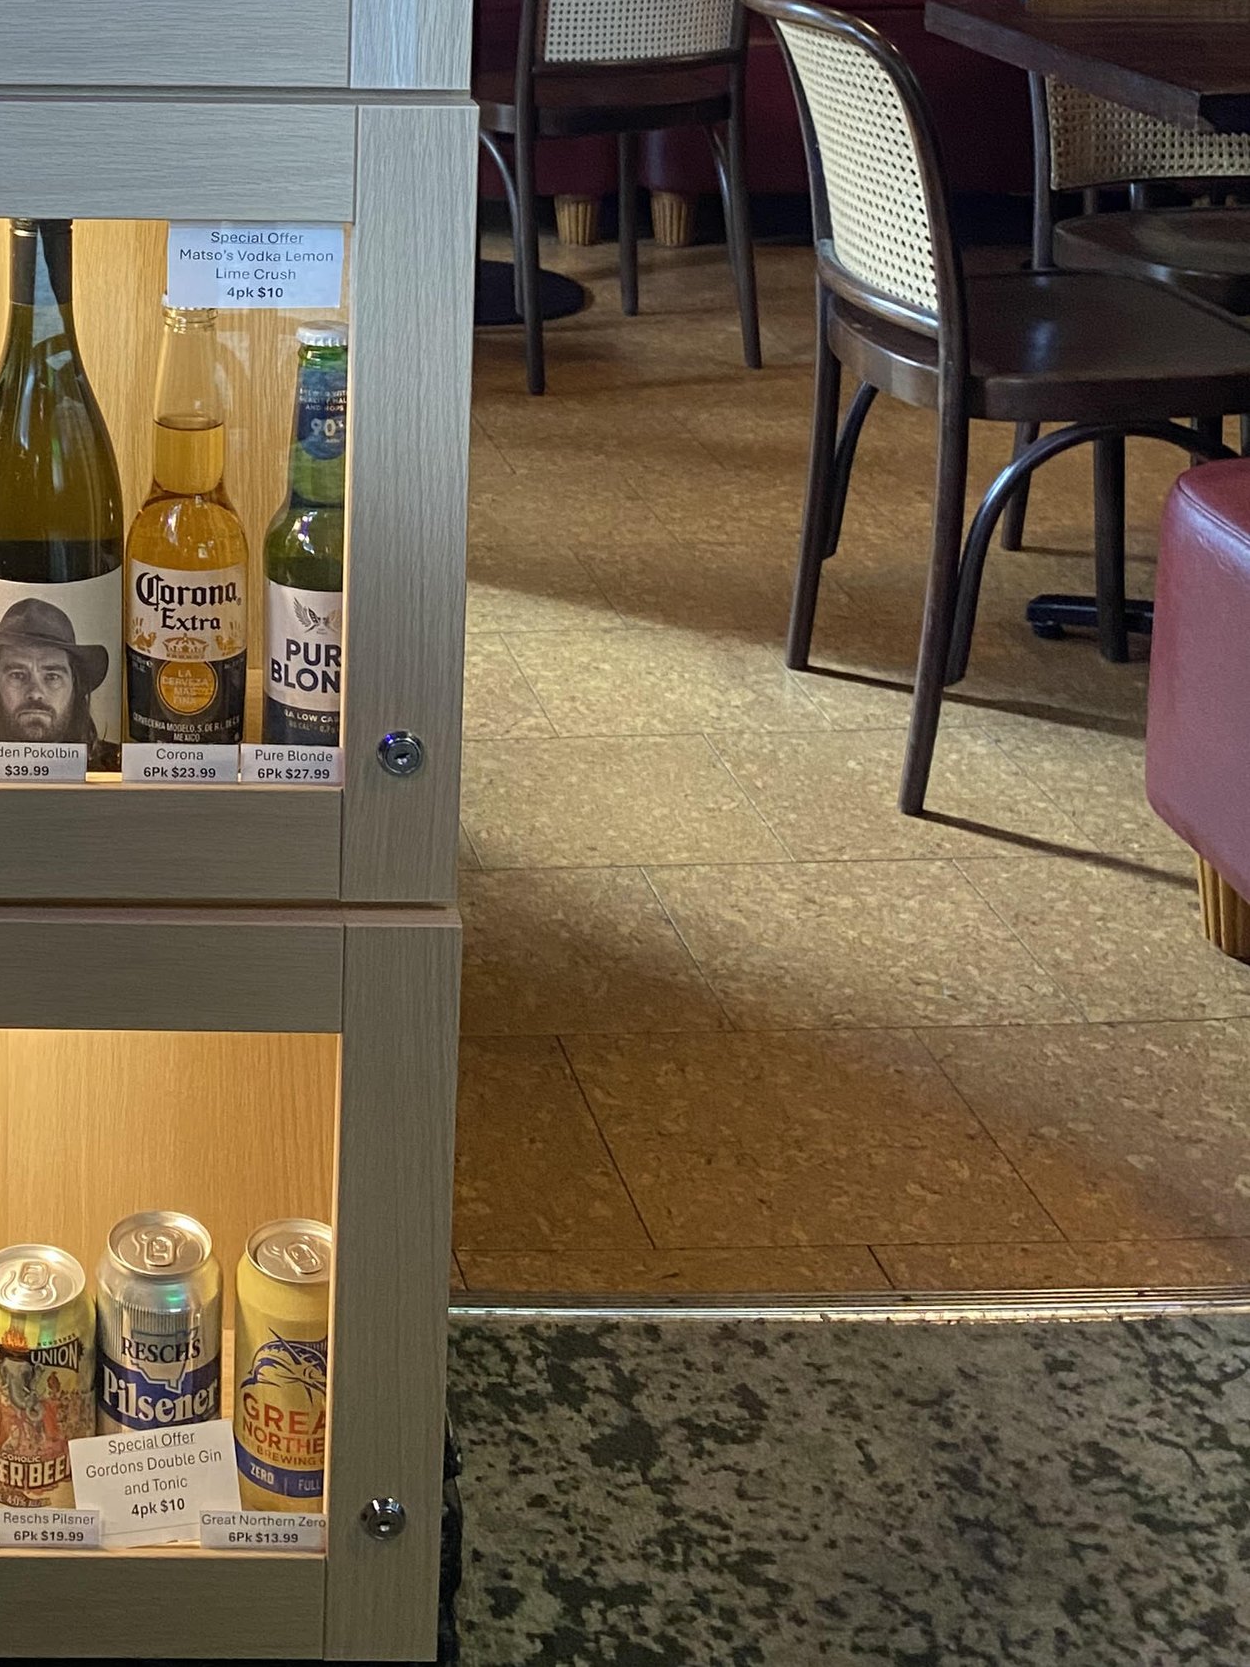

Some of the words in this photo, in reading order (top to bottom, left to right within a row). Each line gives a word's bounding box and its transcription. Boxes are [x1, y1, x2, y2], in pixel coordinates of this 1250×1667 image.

[215, 267, 250, 280] Lime
[253, 267, 297, 281] Crush
[135, 572, 240, 611] Corona
[160, 607, 222, 631] Extra
[296, 711, 318, 722] LOW
[23, 745, 80, 759] Pokolbin
[156, 748, 204, 761] Corona
[254, 748, 284, 762] Pure
[287, 750, 334, 763] Blonde
[4, 764, 50, 778] $39.99
[257, 767, 282, 780] 6Pk
[284, 767, 330, 781] $27.99
[30, 1340, 79, 1370] UNION
[103, 1363, 218, 1423] Pilsener
[86, 1459, 144, 1479] Gordons
[147, 1452, 196, 1471] Double
[198, 1449, 223, 1464] Gin
[250, 1462, 275, 1486] ZERO
[124, 1480, 150, 1496] and
[152, 1476, 188, 1492] Tonic
[3, 1513, 51, 1526] Reschs
[52, 1514, 96, 1526] Pilsner
